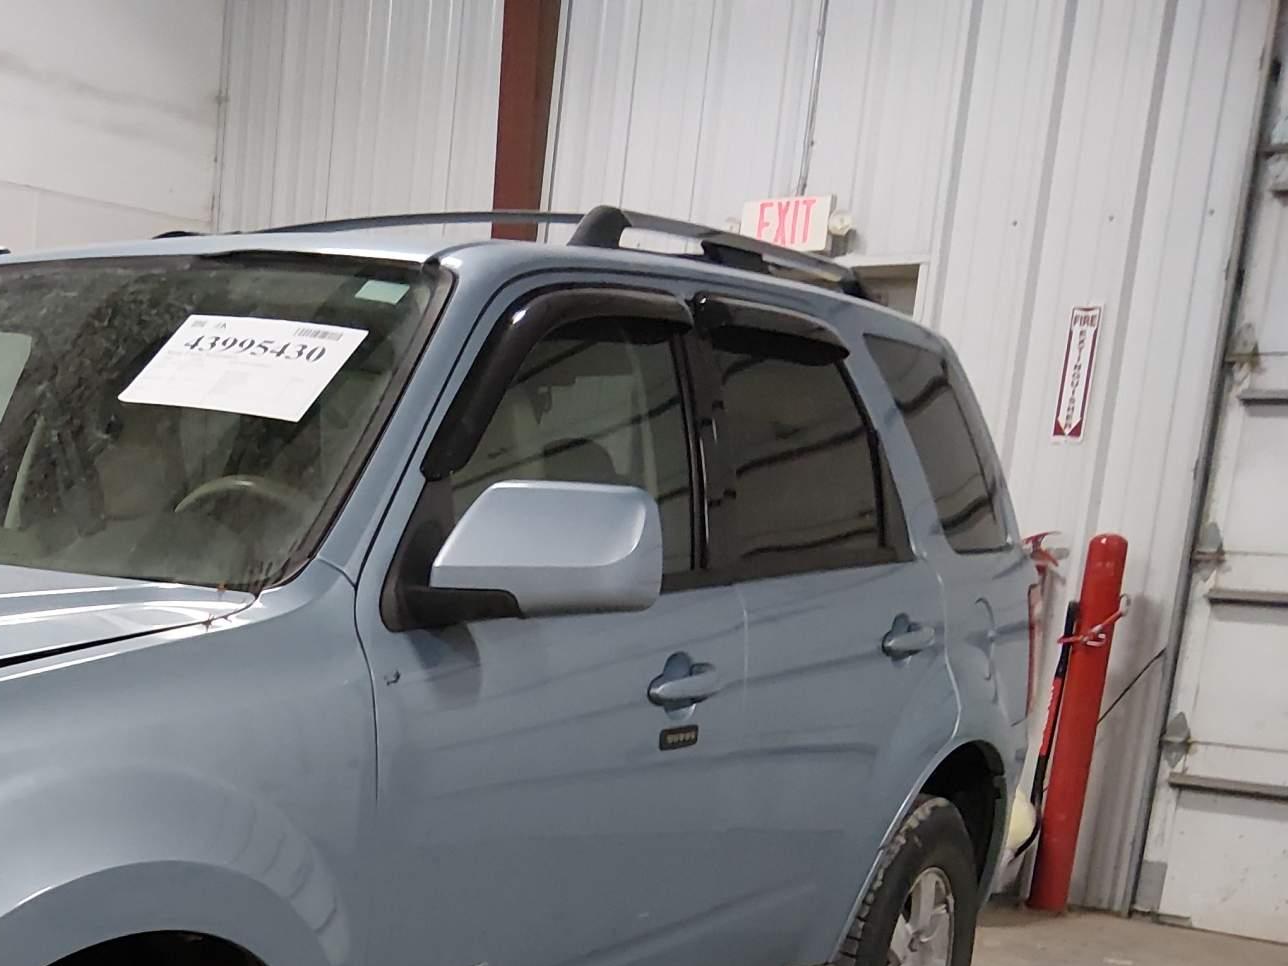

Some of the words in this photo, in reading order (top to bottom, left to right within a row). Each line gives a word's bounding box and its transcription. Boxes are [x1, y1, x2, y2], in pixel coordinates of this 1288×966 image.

[756, 199, 817, 246] EXIT
[1073, 314, 1098, 327] FIRE
[184, 335, 326, 362] 43995430
